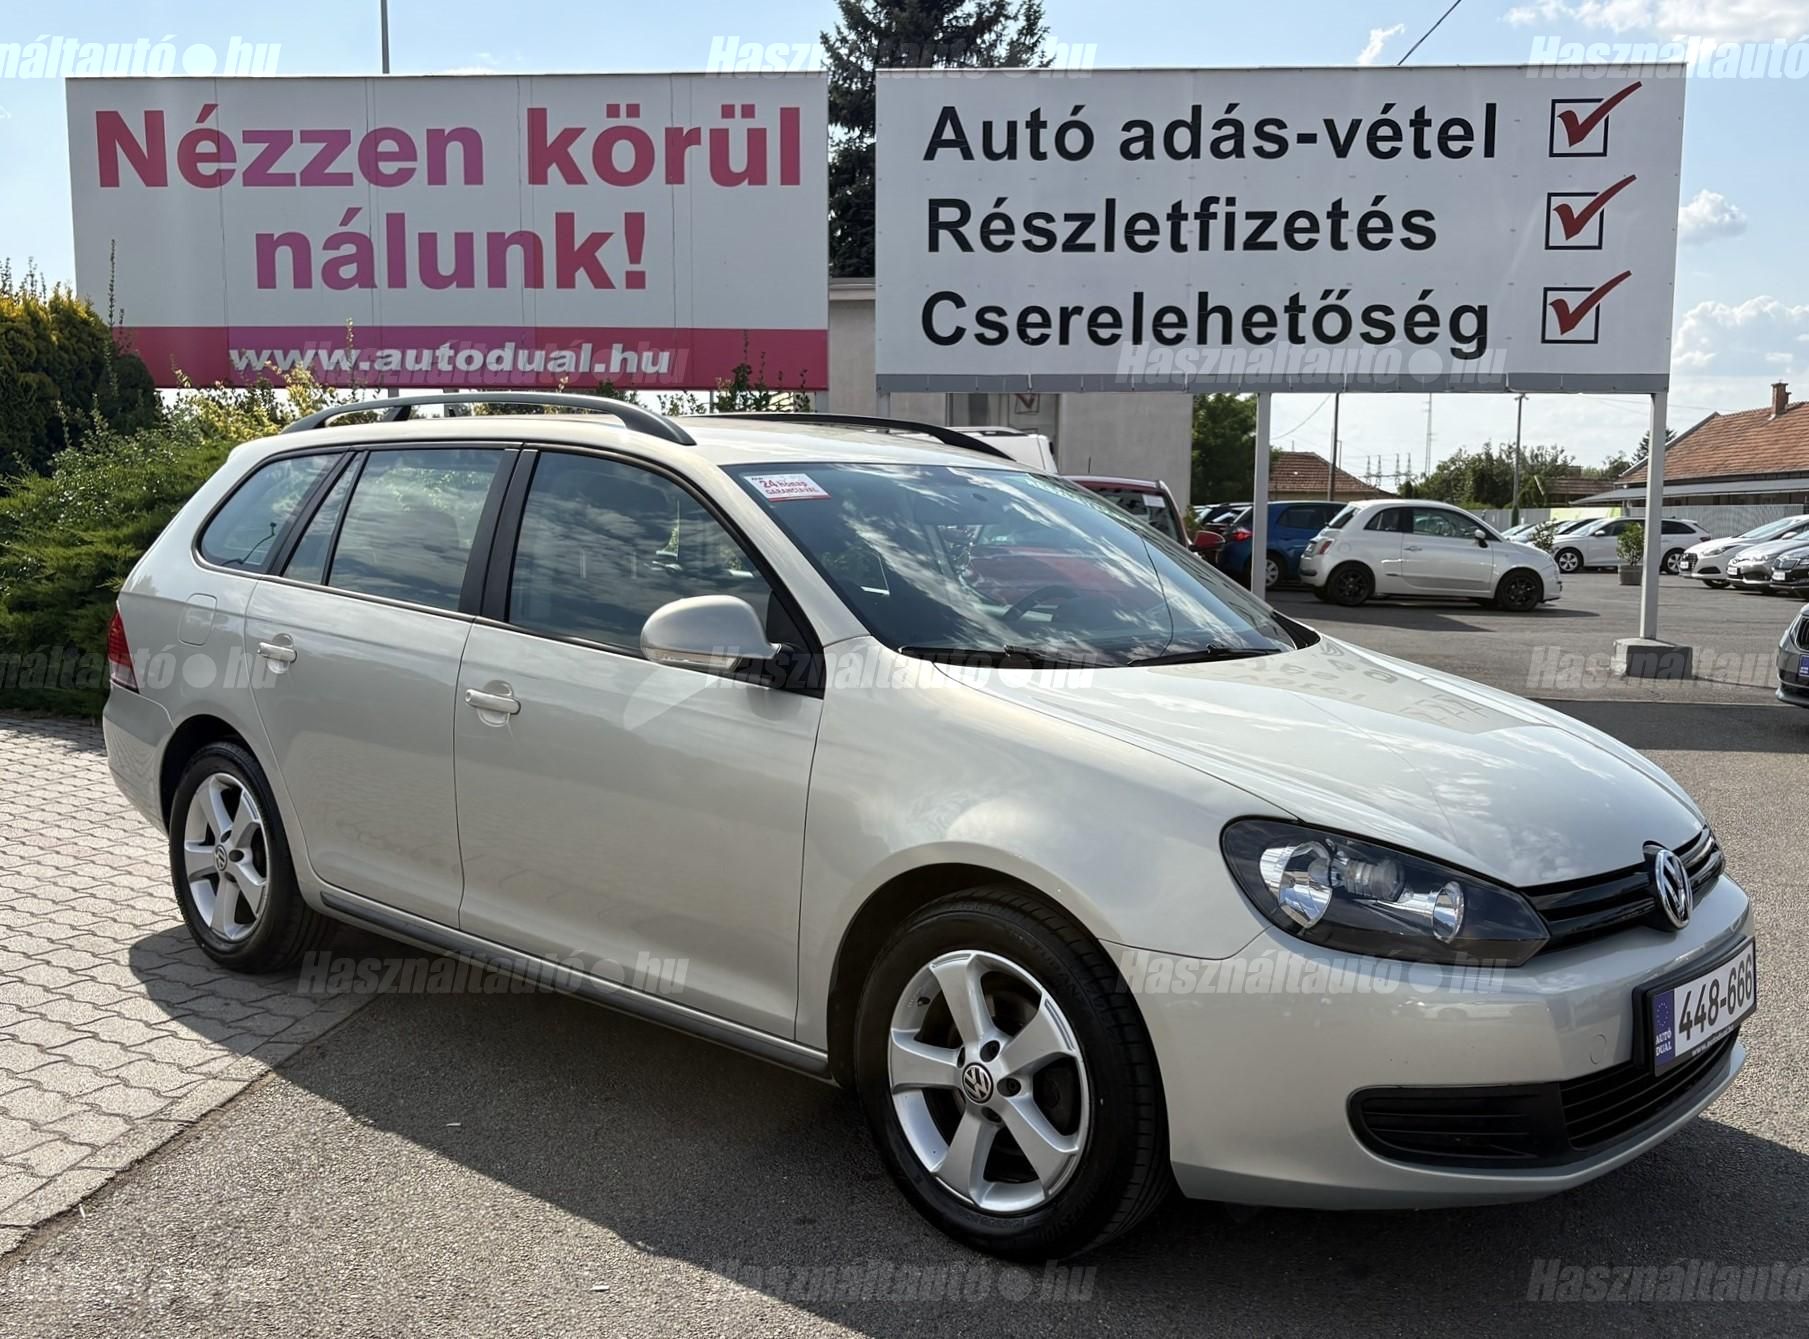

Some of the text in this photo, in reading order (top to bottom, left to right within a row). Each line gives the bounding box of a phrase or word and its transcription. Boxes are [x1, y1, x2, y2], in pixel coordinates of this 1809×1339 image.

[95, 103, 801, 188] Nézzen körül
[923, 102, 1498, 162] Autó adás-vétel
[255, 207, 647, 291] nálunk!
[927, 196, 1438, 254] Részletfizetés
[229, 342, 670, 373] www.autodual.hu
[920, 288, 1490, 360] Cserelehetőség
[1678, 954, 1753, 1041] 448-666
